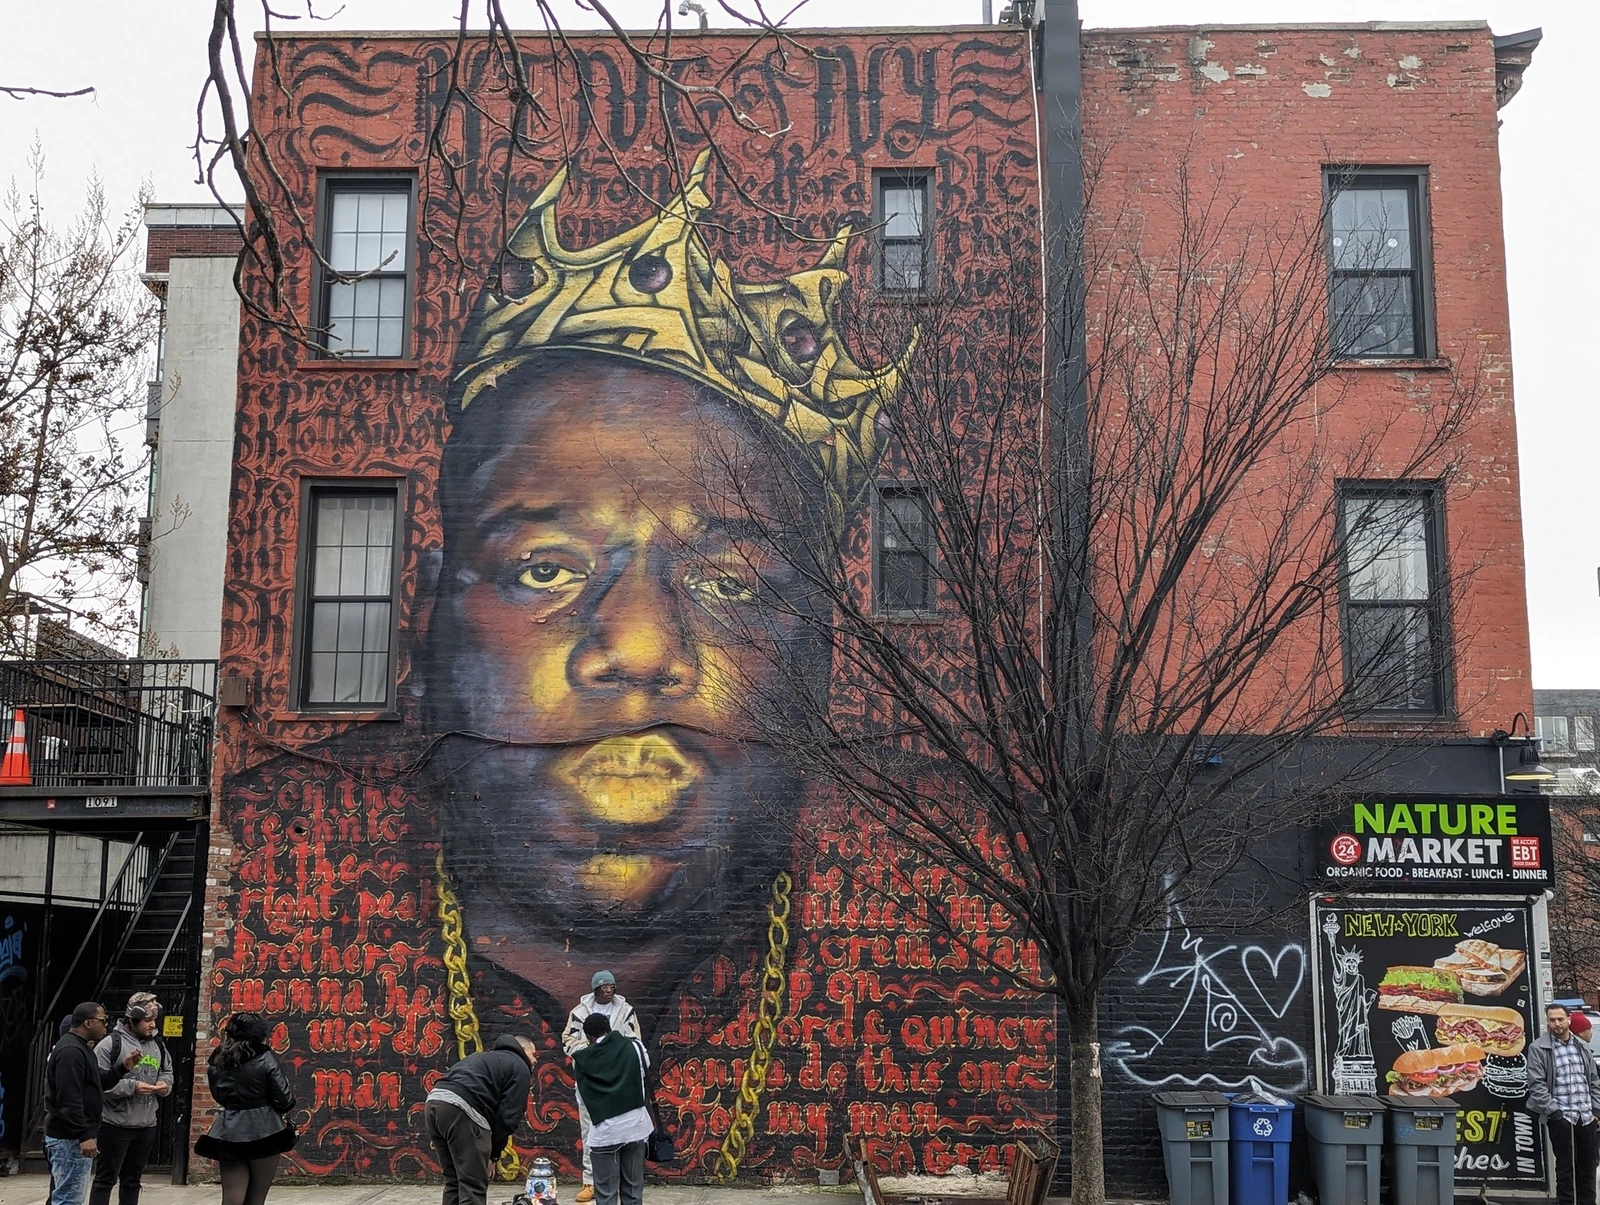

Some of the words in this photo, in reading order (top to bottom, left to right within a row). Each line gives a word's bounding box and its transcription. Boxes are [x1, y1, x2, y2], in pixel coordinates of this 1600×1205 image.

[86, 797, 118, 808] 1091
[1354, 803, 1518, 835] NATURE
[1338, 844, 1356, 857] 24
[1366, 836, 1503, 864] MARKET
[1512, 846, 1538, 861] EBT
[1326, 866, 1373, 879] ORGANIC
[1375, 867, 1403, 878] FOOD
[1412, 868, 1463, 879] BREAKFAST
[1471, 869, 1504, 880] LUNCH
[1512, 869, 1548, 880] DINNER
[1344, 913, 1395, 937] NEW
[1402, 913, 1459, 937] YORK
[1513, 1111, 1534, 1152] TOWN
[1516, 1156, 1535, 1174] IN
